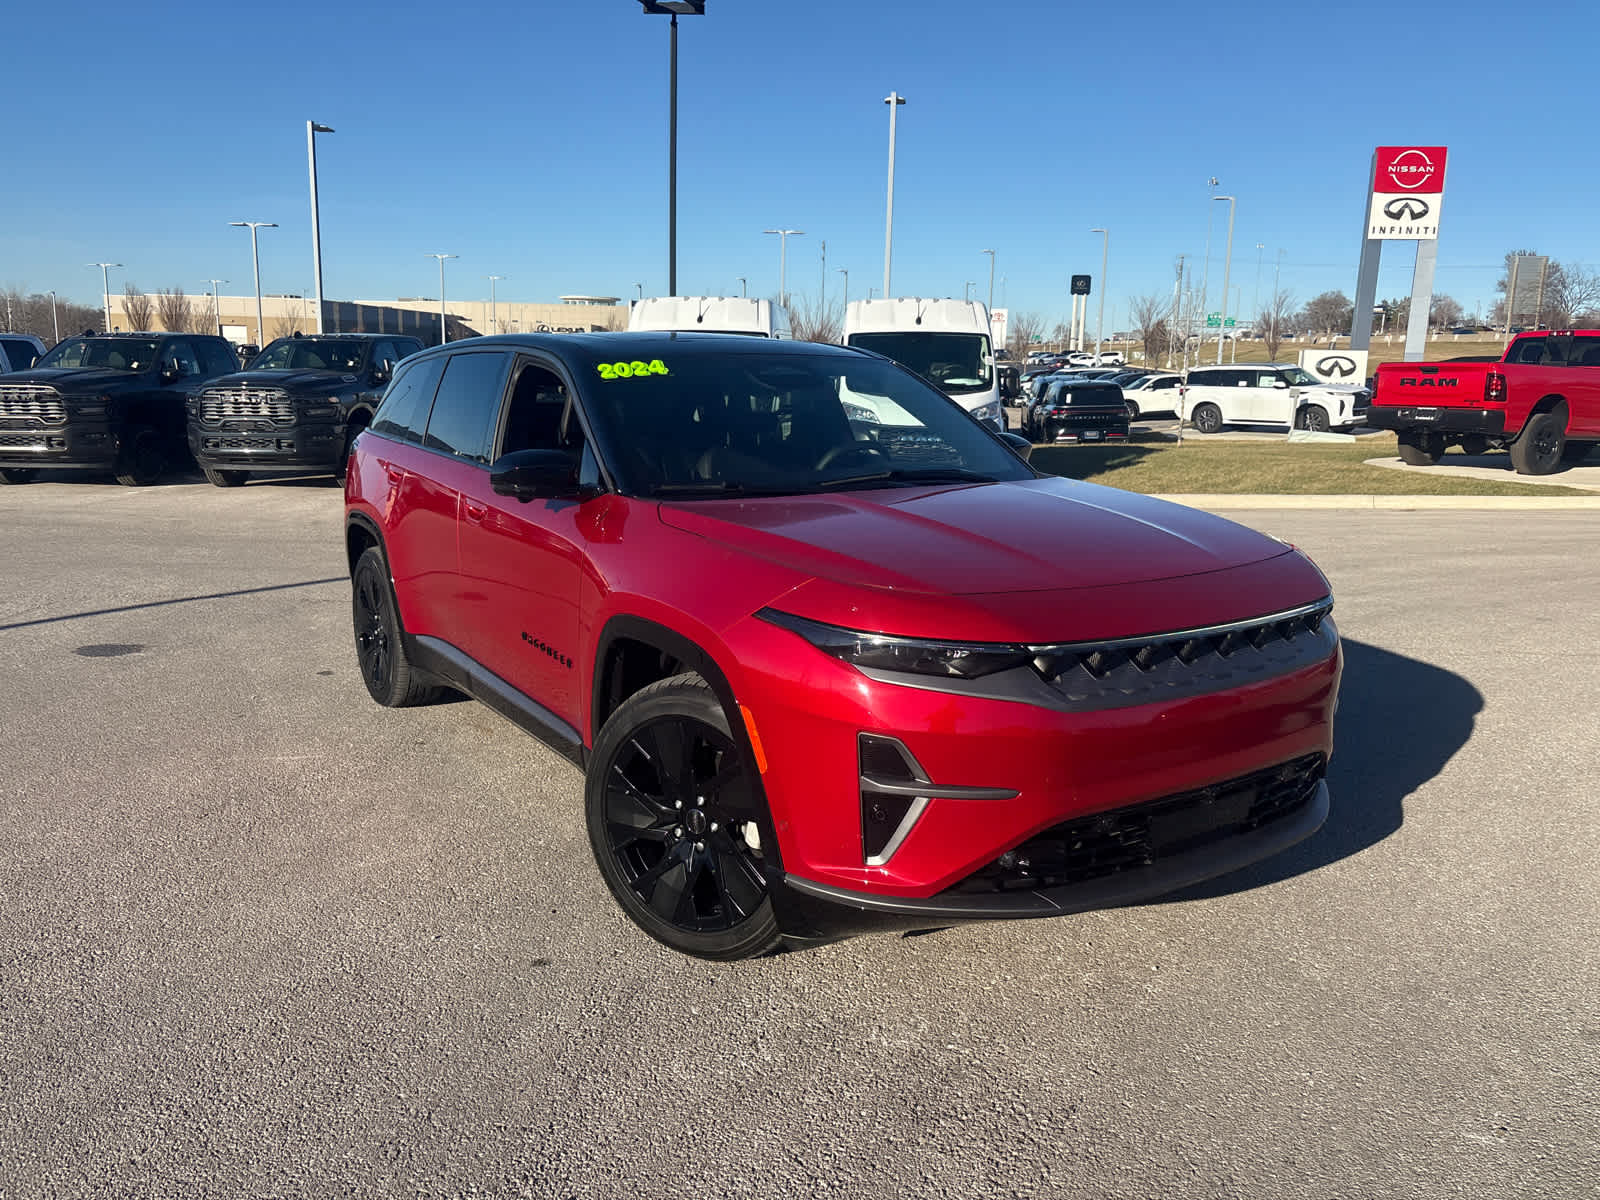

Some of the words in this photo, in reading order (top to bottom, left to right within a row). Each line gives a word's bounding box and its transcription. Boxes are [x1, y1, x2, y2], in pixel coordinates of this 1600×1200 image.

[1387, 165, 1434, 173] NISSAN
[1371, 226, 1436, 235] INFINITI
[597, 359, 669, 379] 2024
[1400, 377, 1459, 387] RAM
